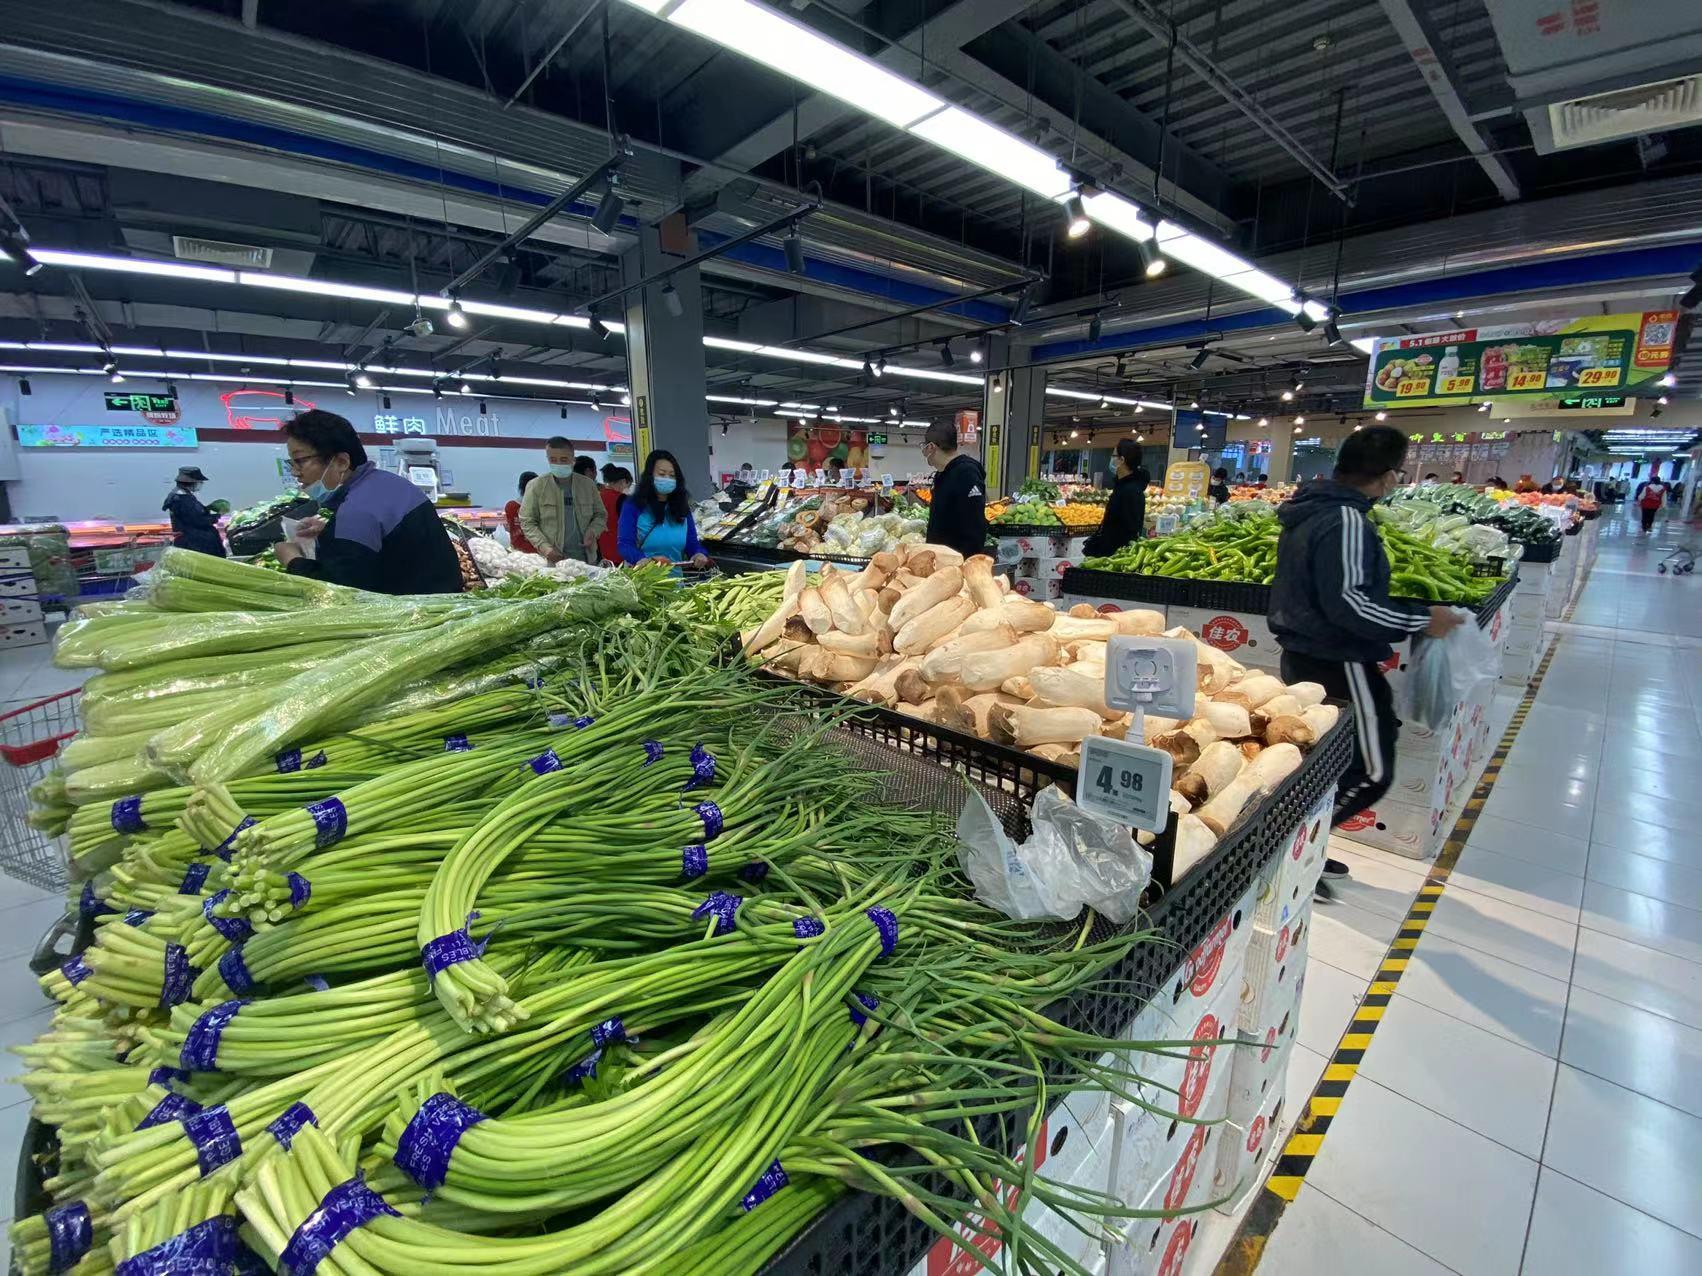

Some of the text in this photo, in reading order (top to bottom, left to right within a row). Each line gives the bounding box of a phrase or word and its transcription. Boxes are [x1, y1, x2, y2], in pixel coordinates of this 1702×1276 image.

[101, 428, 158, 437] 严选精品区
[374, 406, 501, 436] 鲜肉 Meat
[1209, 625, 1241, 642] 佳农
[1096, 765, 1143, 796] 4.98
[410, 1127, 434, 1168] FRESH
